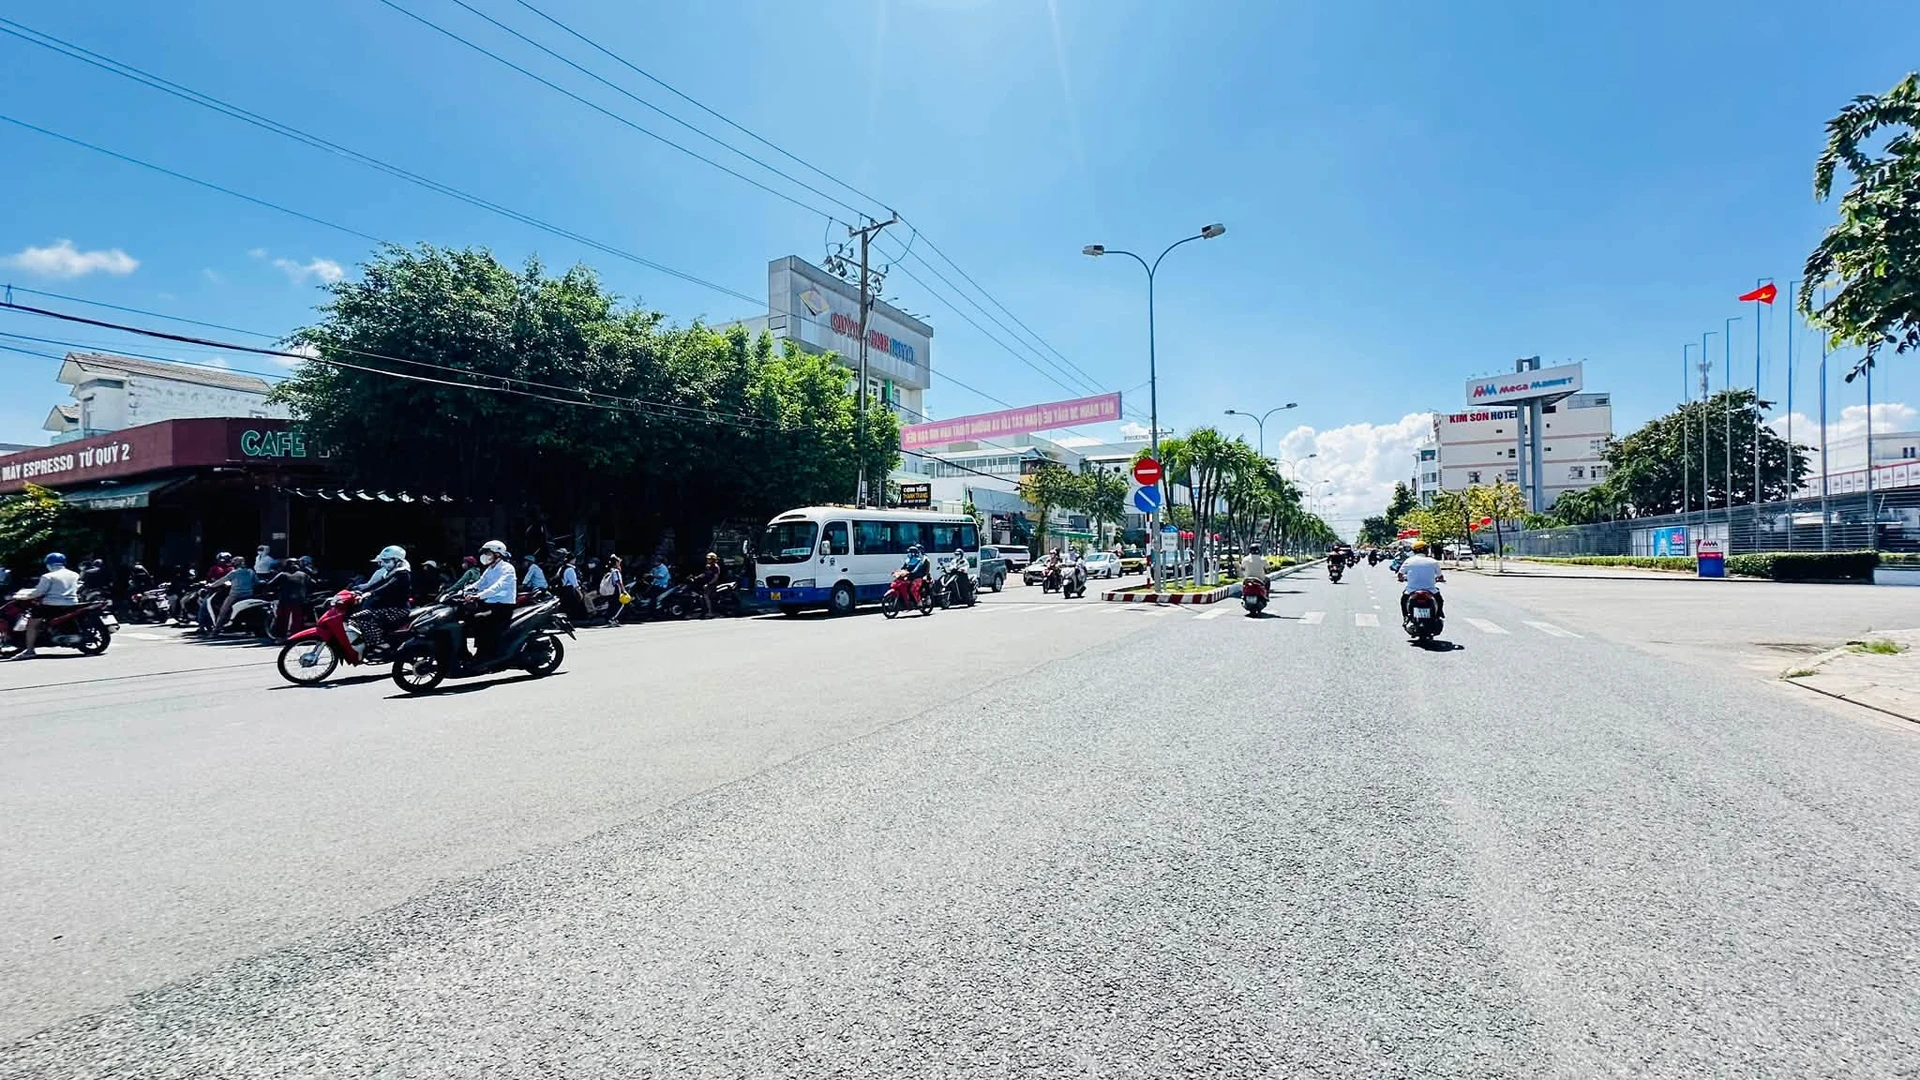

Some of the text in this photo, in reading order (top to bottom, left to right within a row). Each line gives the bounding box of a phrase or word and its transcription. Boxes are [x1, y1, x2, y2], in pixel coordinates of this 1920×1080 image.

[1449, 414, 1468, 424] KIM
[1469, 412, 1490, 423] SON
[2, 461, 21, 481] MÁY
[23, 454, 74, 478] ESPRESSO
[96, 441, 119, 466] QUÝ
[121, 443, 130, 461] 2
